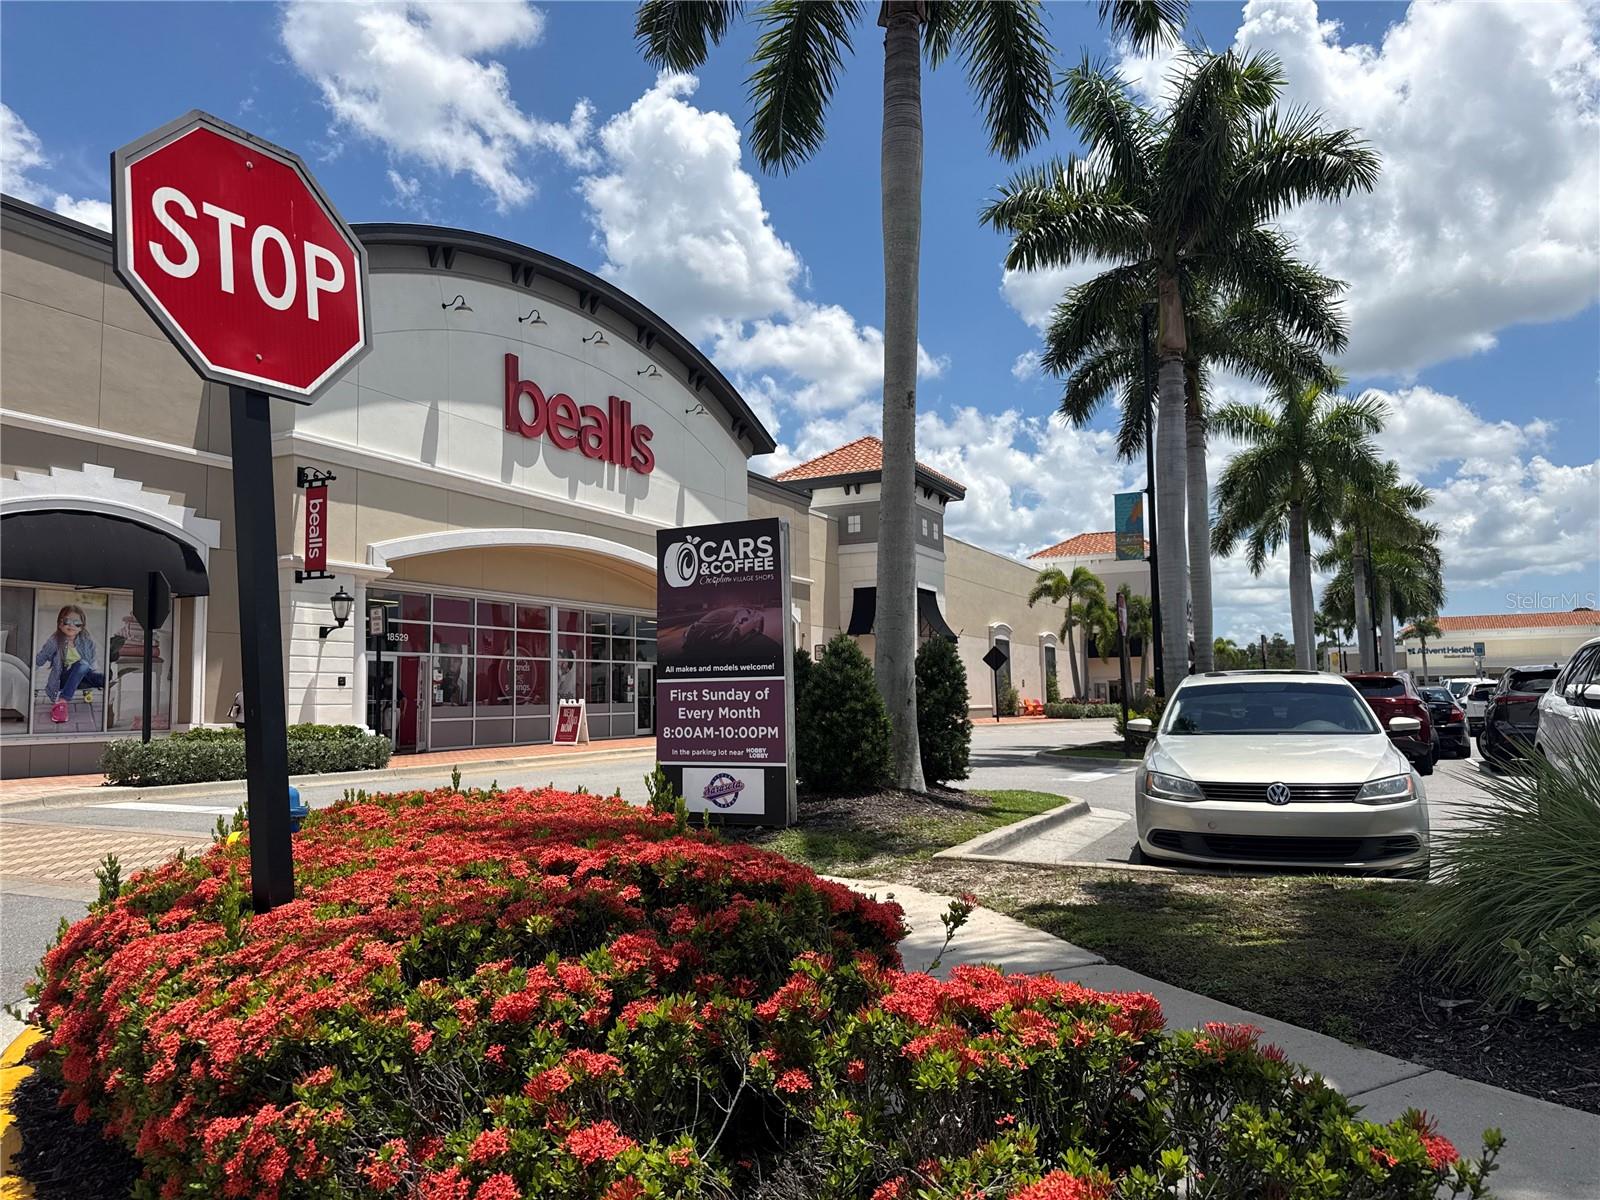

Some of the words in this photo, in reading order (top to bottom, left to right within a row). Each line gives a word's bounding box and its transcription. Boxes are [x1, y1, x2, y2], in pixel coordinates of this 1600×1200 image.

[149, 186, 346, 322] STOP
[505, 353, 655, 475] bealls
[308, 498, 324, 559] bealls
[700, 536, 773, 562] CARS
[700, 557, 774, 575] &COFFEE
[386, 633, 409, 642] 18529
[676, 665, 697, 673] makes
[698, 664, 711, 672] and
[713, 663, 739, 671] models
[670, 689, 698, 702] First
[702, 687, 750, 702] Sunday
[755, 687, 770, 700] of
[678, 707, 714, 721] Every
[718, 706, 760, 719] Month
[663, 726, 779, 739] 8:00AM-10:00PM
[691, 749, 717, 757] parking
